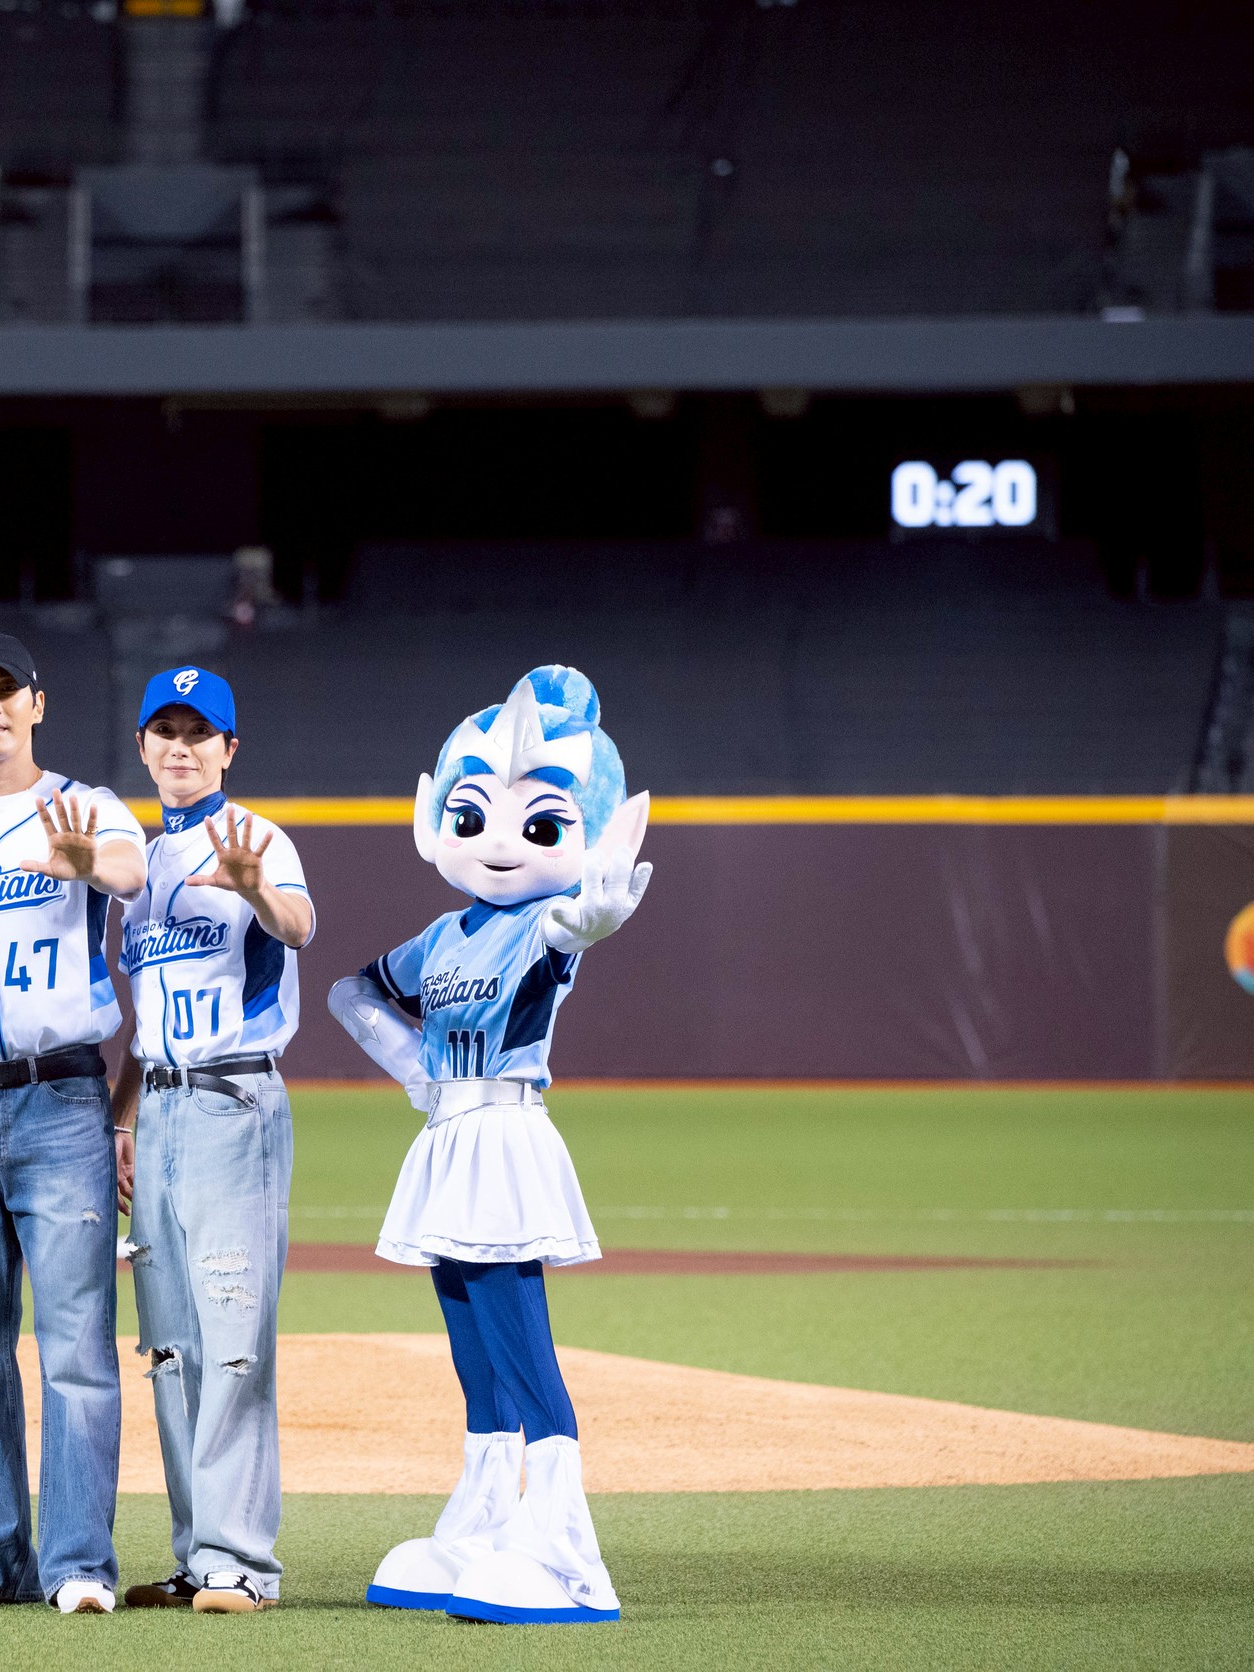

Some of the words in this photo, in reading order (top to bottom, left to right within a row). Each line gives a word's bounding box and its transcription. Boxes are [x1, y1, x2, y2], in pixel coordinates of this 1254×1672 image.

[891, 459, 1037, 527] 0:20
[173, 669, 199, 696] G
[132, 921, 164, 938] FUBON
[4, 938, 59, 992] 47
[172, 986, 222, 1040] 07
[447, 1030, 486, 1078] 111
